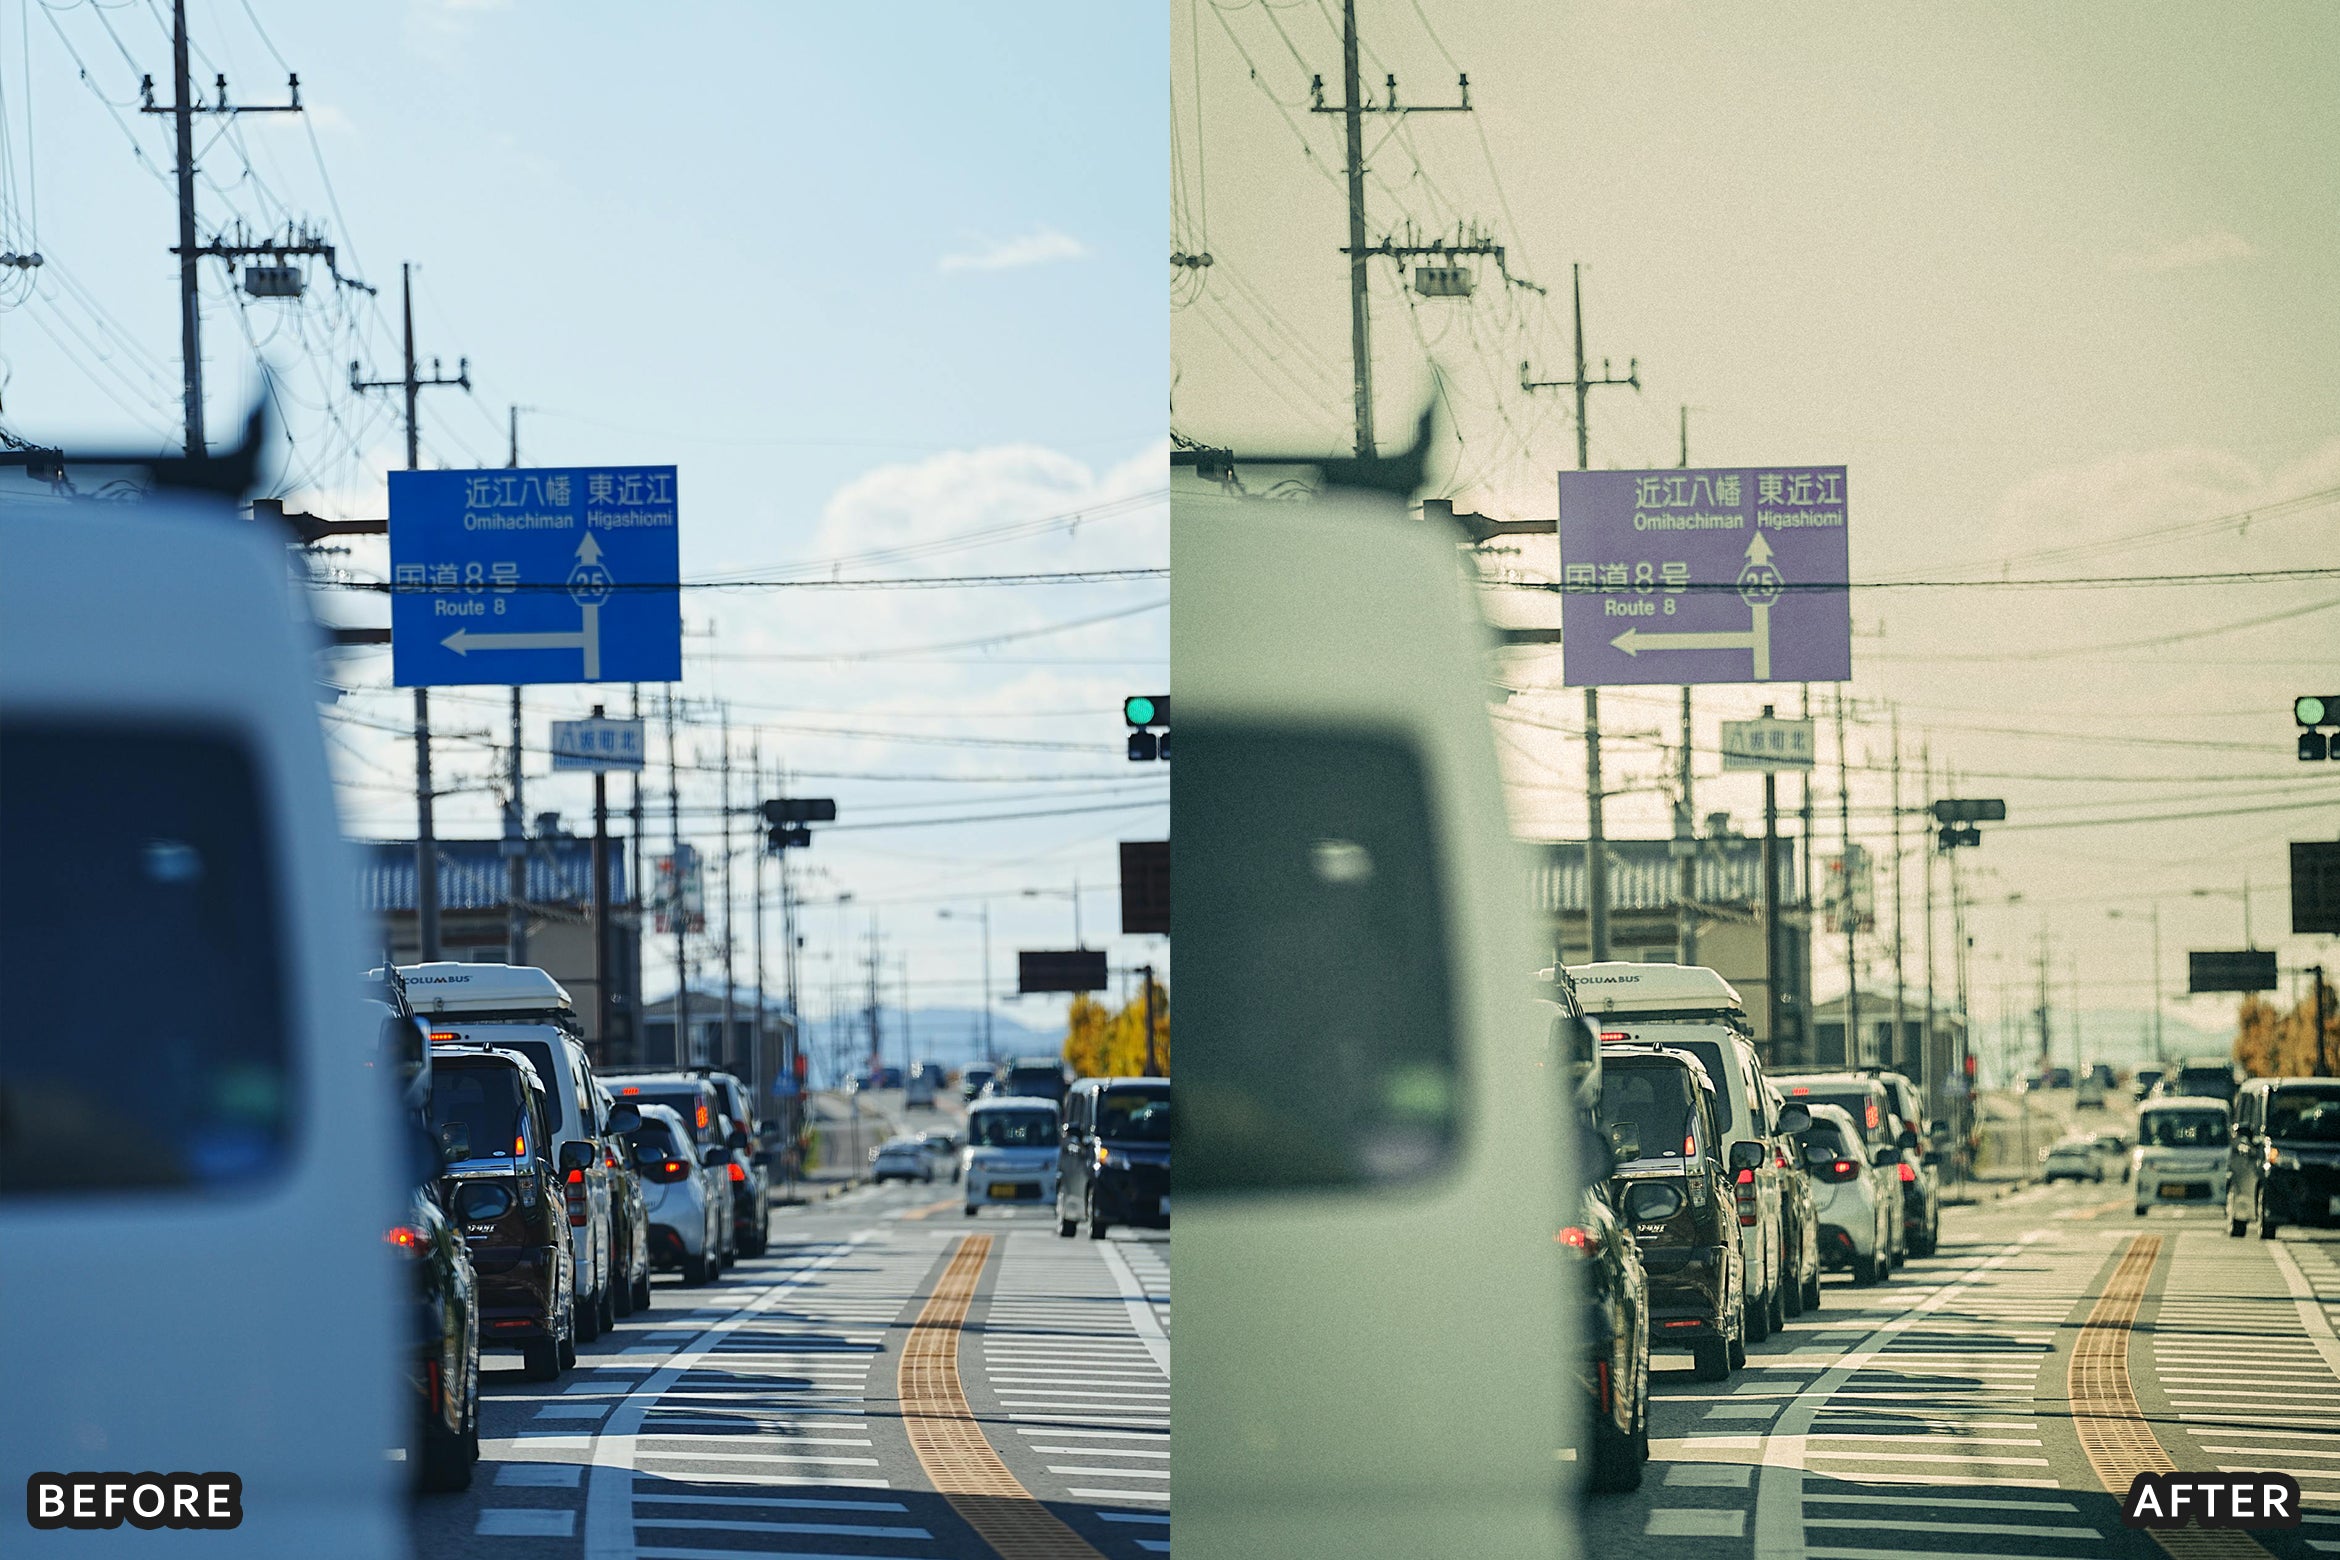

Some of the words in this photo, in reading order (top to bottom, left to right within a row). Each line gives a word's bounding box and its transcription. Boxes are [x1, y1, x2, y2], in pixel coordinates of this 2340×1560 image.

[465, 474, 572, 509] 近江八幡
[588, 473, 673, 506] 東近江
[1635, 474, 1742, 509] 近江八幡
[1758, 473, 1843, 506] 東近江
[464, 512, 574, 531] Omihachiman
[587, 510, 674, 531] Higashiomi
[1634, 512, 1744, 531] Omihachiman
[1757, 510, 1844, 531] Higashiomi
[395, 561, 521, 594] 国道8号
[575, 573, 605, 597] 25
[1565, 561, 1691, 594] 国道8号
[1745, 573, 1775, 597] 25
[435, 599, 485, 616] Route
[493, 598, 506, 615] 8
[1605, 599, 1655, 616] Route
[1663, 598, 1676, 615] 8
